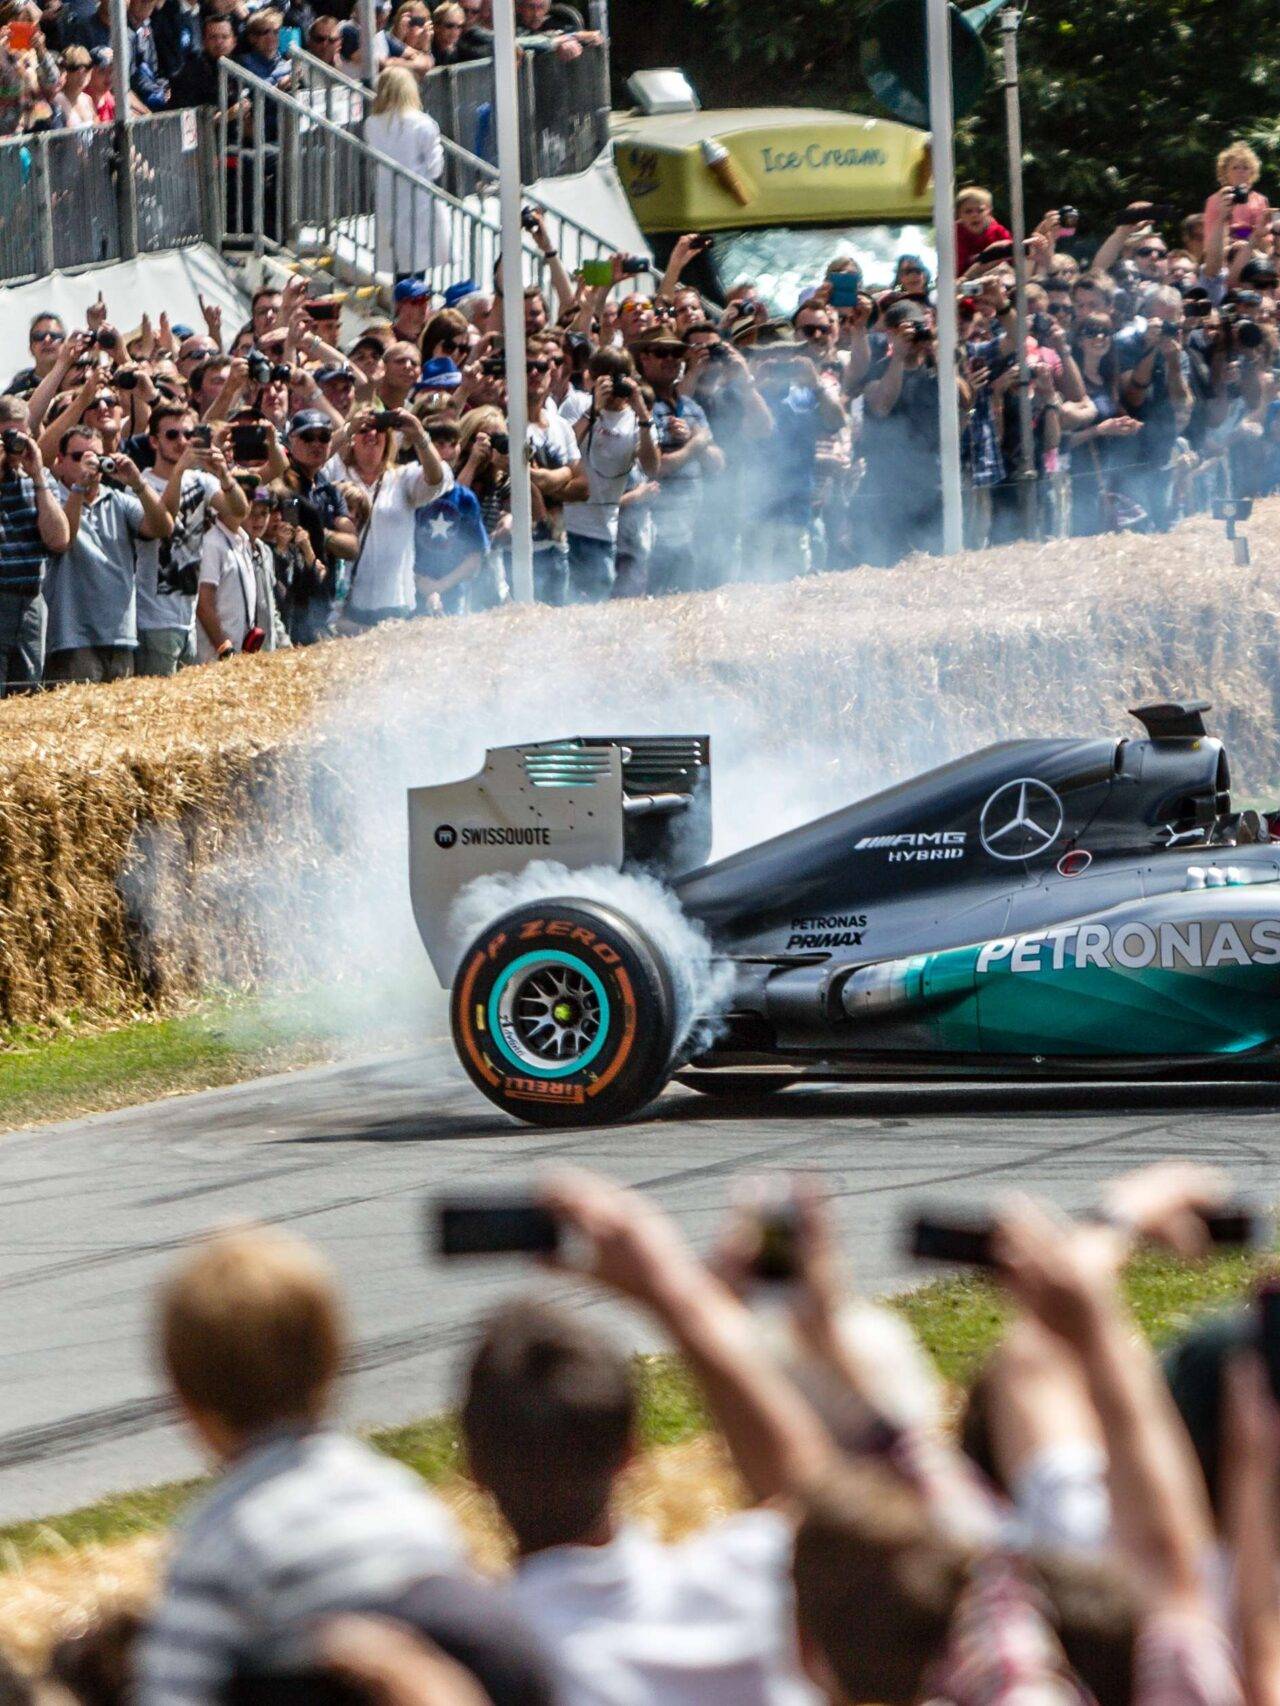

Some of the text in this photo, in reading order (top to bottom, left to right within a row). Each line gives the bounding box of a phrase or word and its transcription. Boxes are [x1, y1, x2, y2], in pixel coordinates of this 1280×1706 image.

[762, 143, 886, 172] Ice Cream
[461, 827, 551, 846] SWISSQUOTE
[891, 831, 967, 847] AMG
[888, 848, 965, 862] HYBRID
[791, 914, 867, 931] PETRONAS
[519, 919, 621, 964] ZERO
[784, 931, 871, 950] PRIMAX
